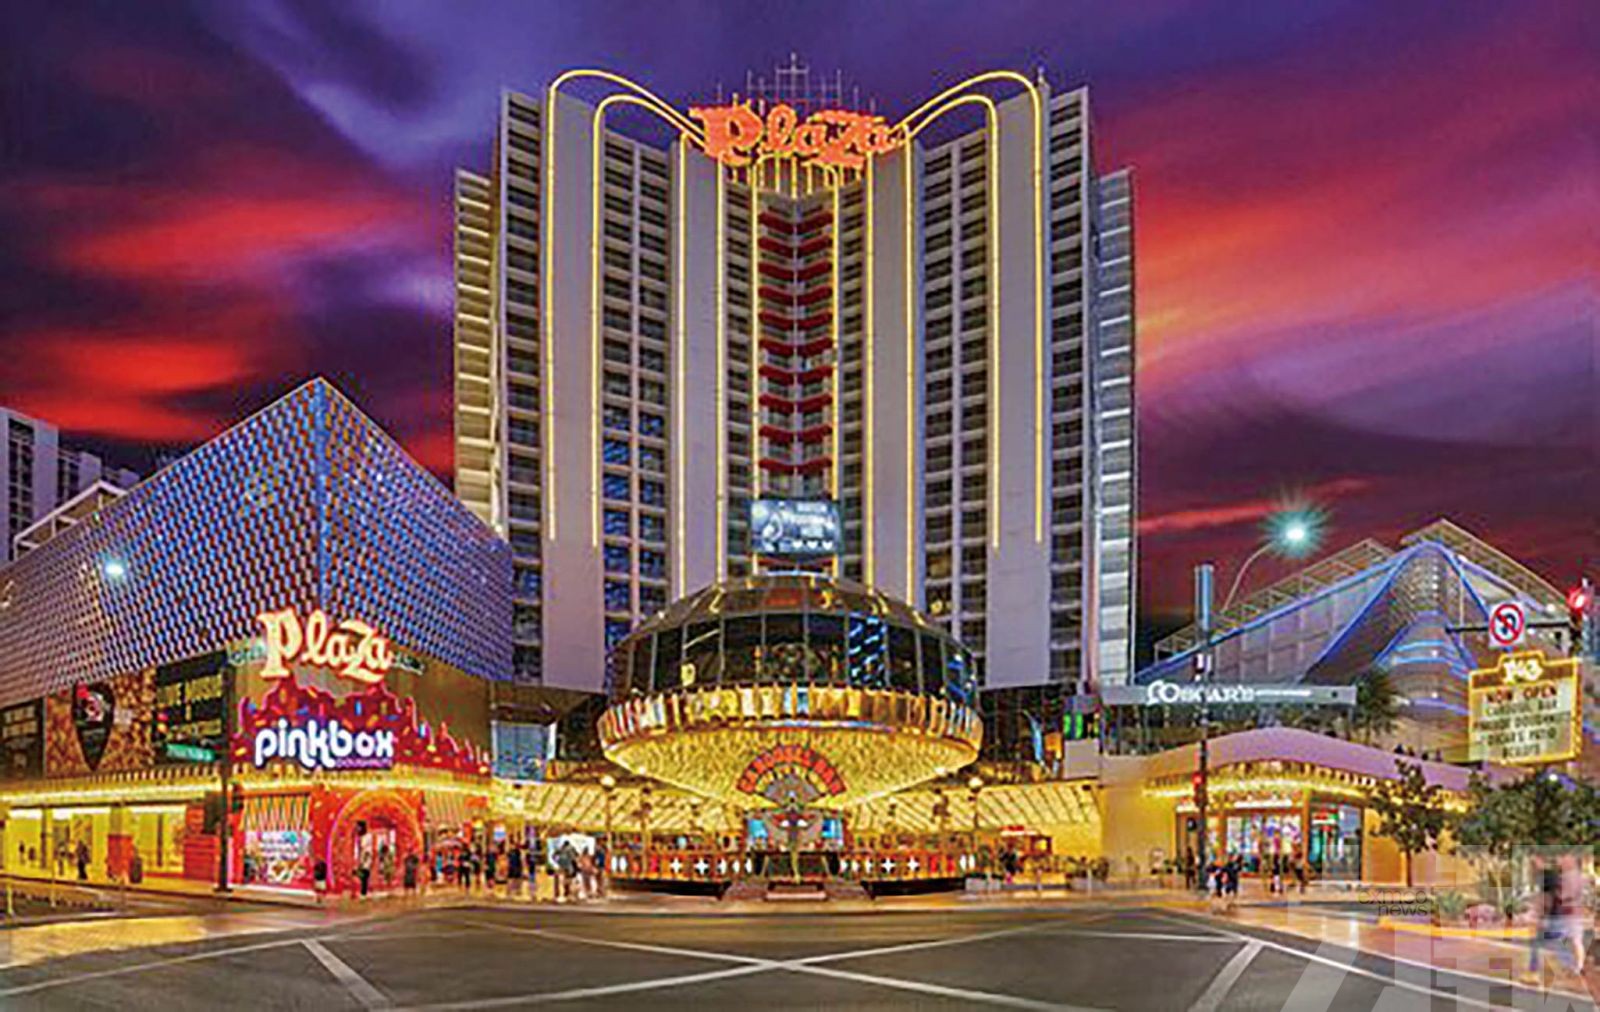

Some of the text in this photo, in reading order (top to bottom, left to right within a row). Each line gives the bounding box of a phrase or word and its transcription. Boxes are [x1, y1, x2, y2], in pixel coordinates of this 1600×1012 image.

[689, 103, 897, 169] Plaza
[256, 608, 394, 682] Plaza
[1523, 685, 1557, 699] OPEN
[255, 718, 394, 768] pinkbox
